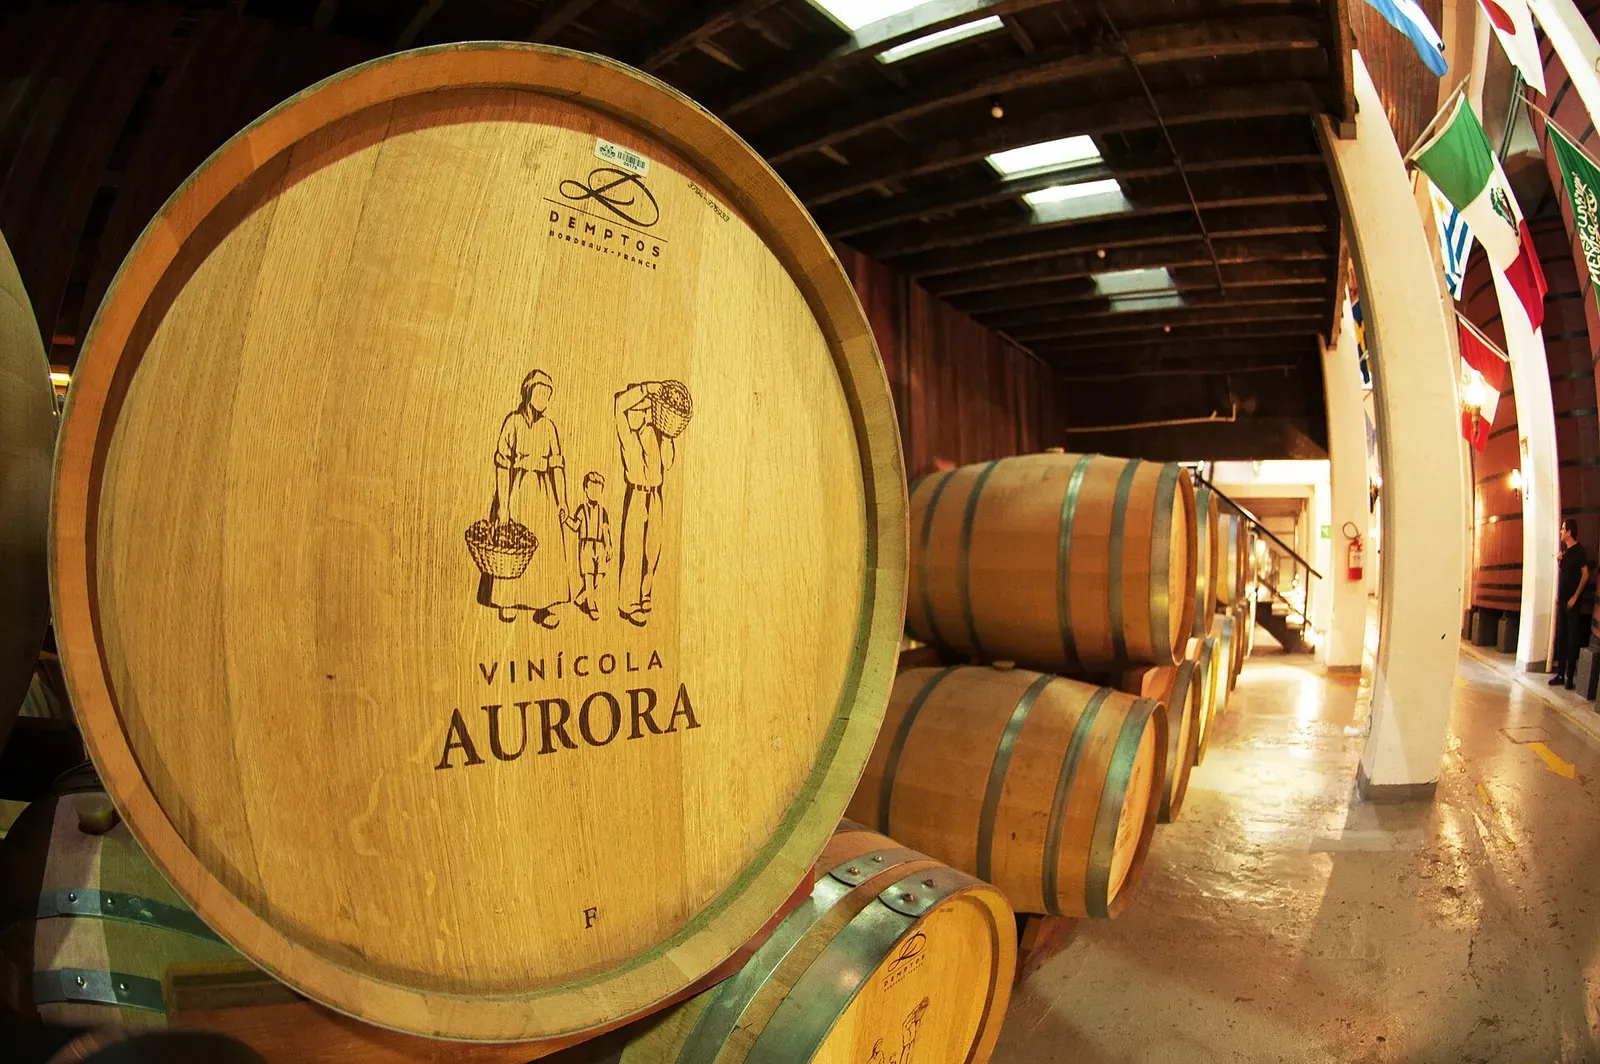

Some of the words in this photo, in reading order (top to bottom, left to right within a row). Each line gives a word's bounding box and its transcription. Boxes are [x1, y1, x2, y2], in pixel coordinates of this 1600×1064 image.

[549, 210, 661, 258] DEMPTOS
[478, 649, 664, 686] VINÍCOLA
[434, 682, 701, 770] AURORA
[582, 906, 597, 929] F
